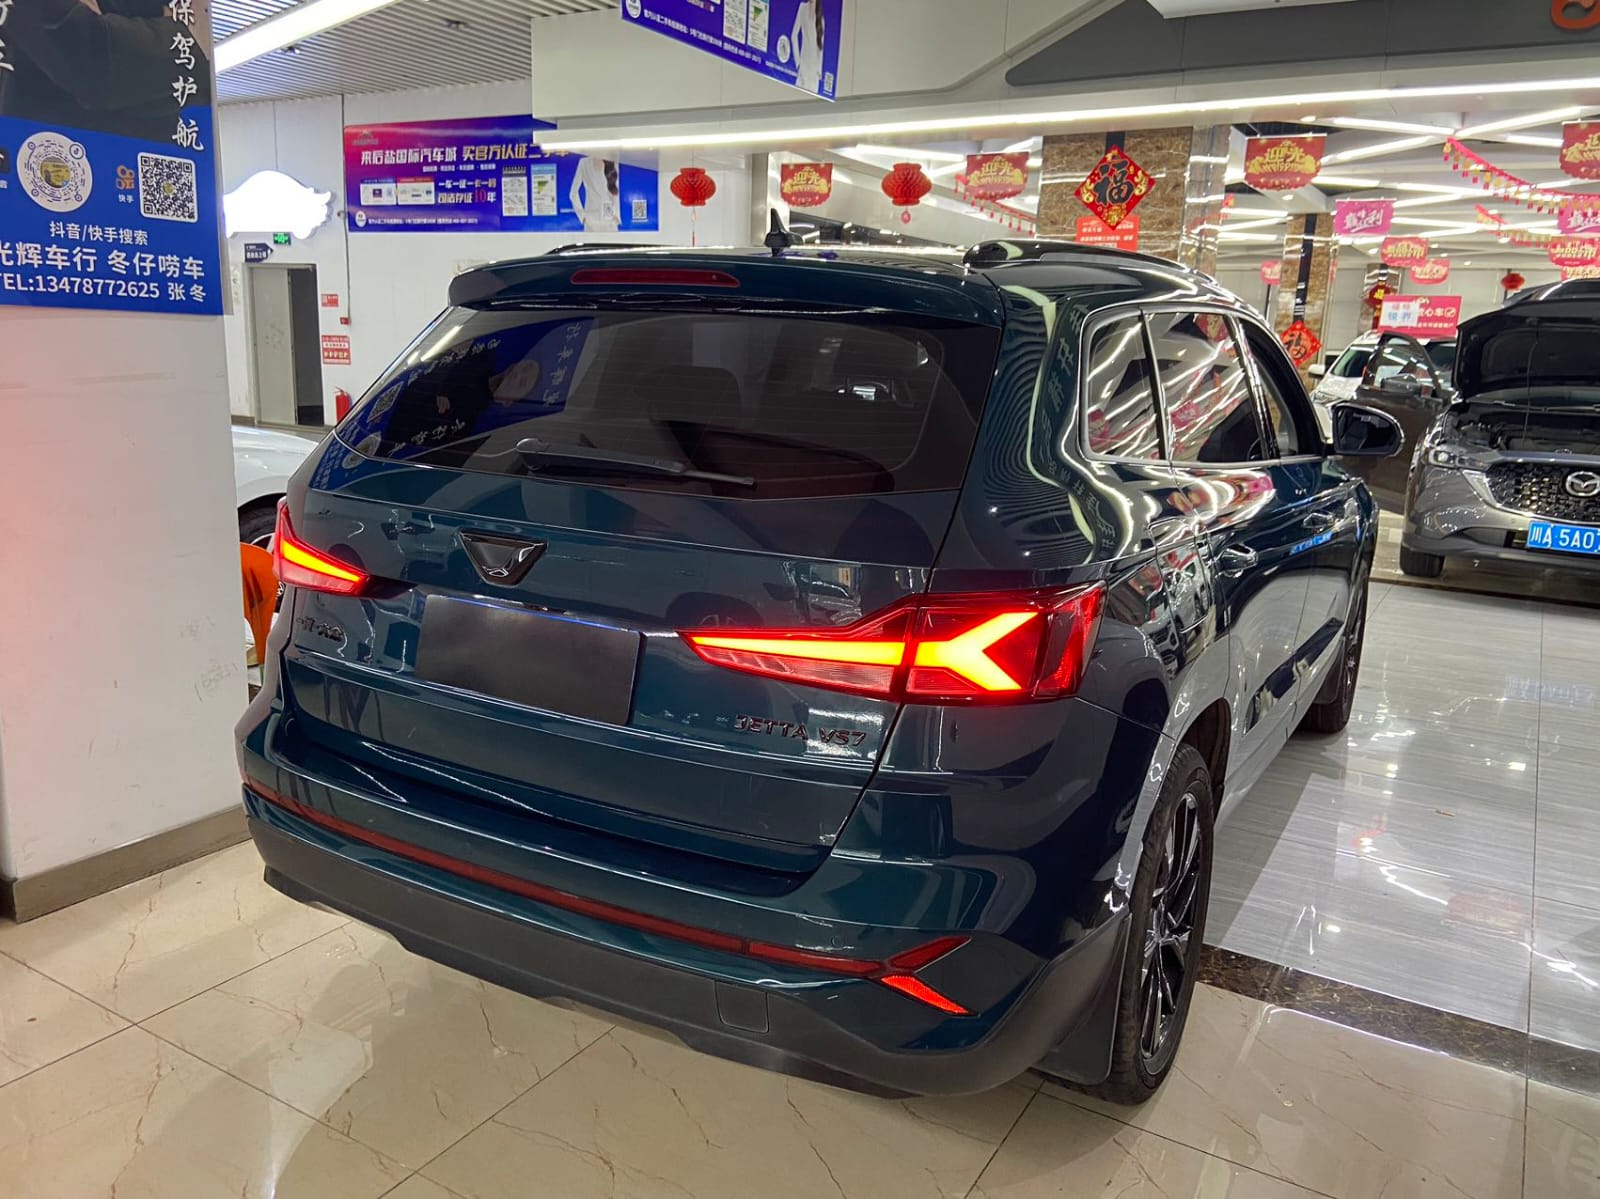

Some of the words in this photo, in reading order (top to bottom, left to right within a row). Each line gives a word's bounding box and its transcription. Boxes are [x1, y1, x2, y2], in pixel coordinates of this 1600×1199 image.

[168, 0, 204, 150] 保驾护航
[1093, 159, 1135, 207] 福
[50, 221, 148, 246] 抖音/快手搜索
[108, 250, 205, 280] 冬仔唠车
[0, 273, 160, 299] EL:13478772625
[734, 714, 809, 741] JETTA
[817, 727, 867, 747] VS7
